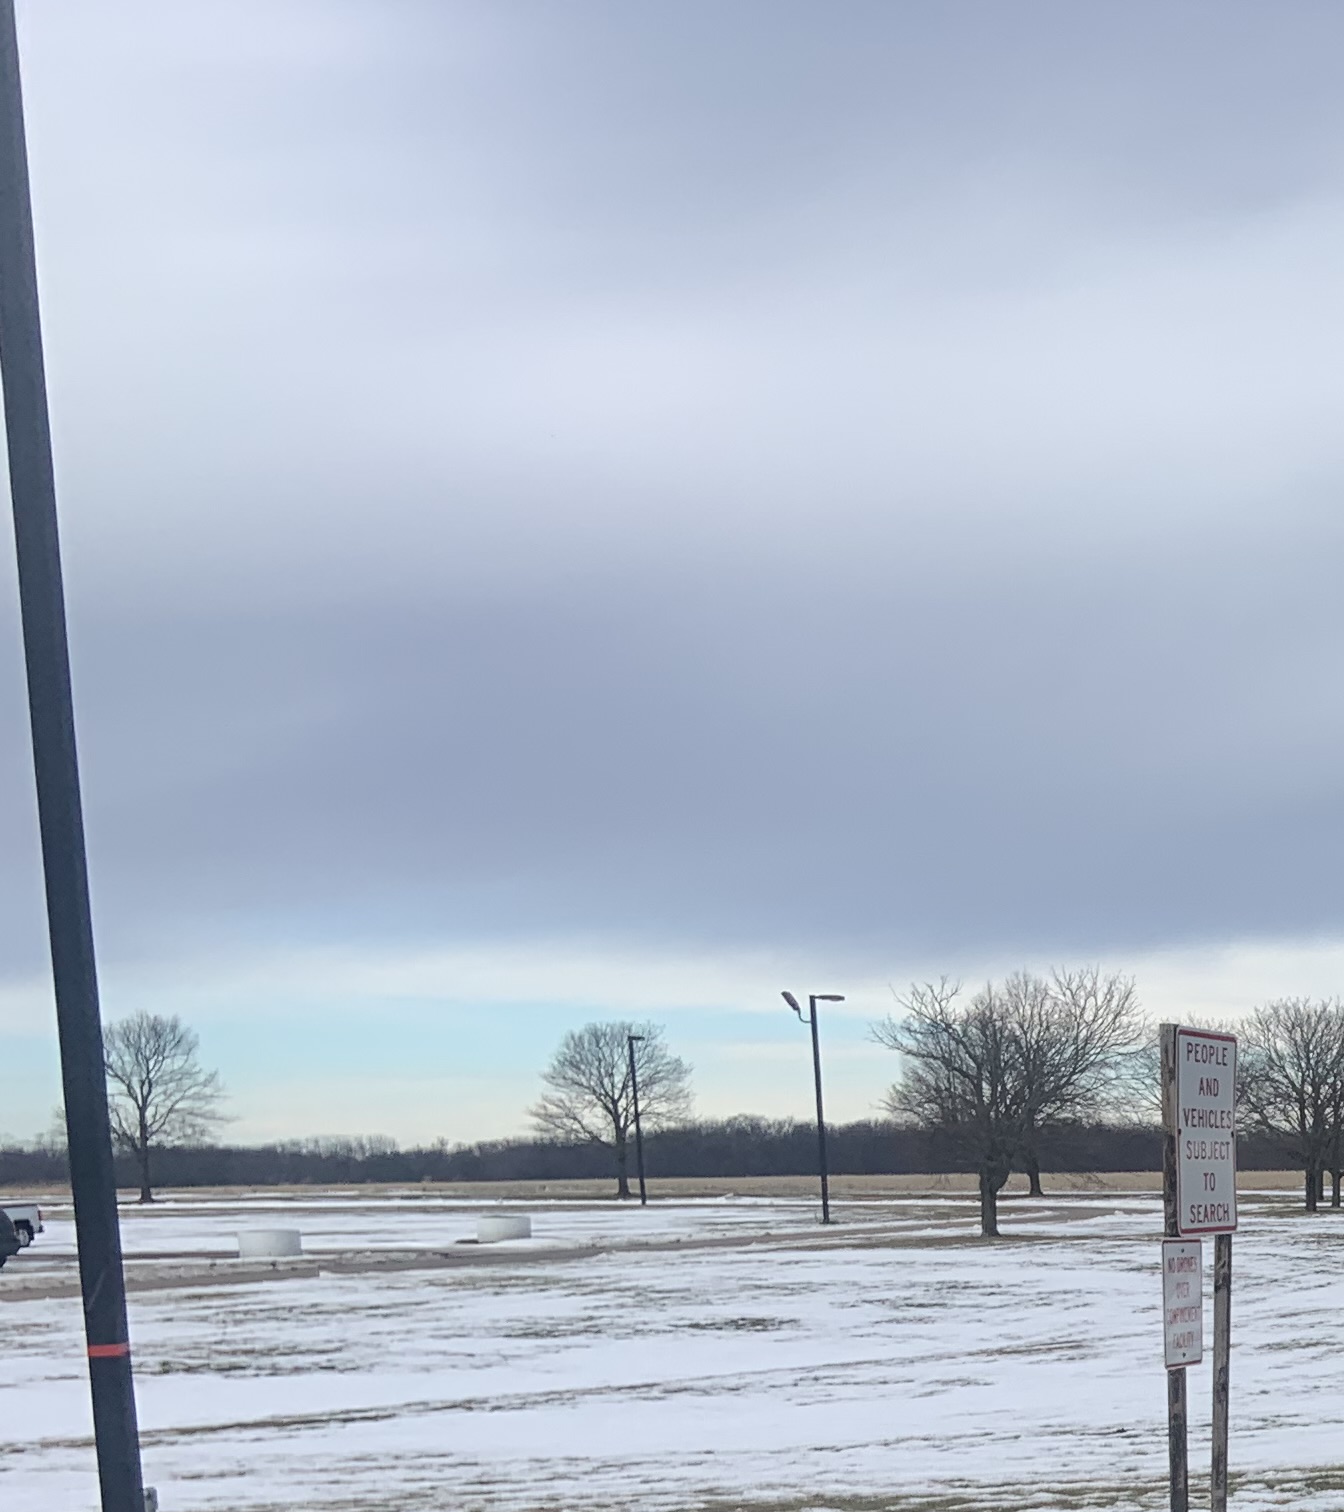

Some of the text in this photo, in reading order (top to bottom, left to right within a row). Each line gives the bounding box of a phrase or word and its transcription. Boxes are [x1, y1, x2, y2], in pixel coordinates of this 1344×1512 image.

[1186, 1042, 1228, 1066] PEOPLE
[1198, 1077, 1220, 1097] AND
[1183, 1107, 1232, 1129] VEHICLES
[1186, 1140, 1230, 1160] SUBJECT
[1203, 1172, 1216, 1191] TO
[1189, 1203, 1230, 1224] SEARCH
